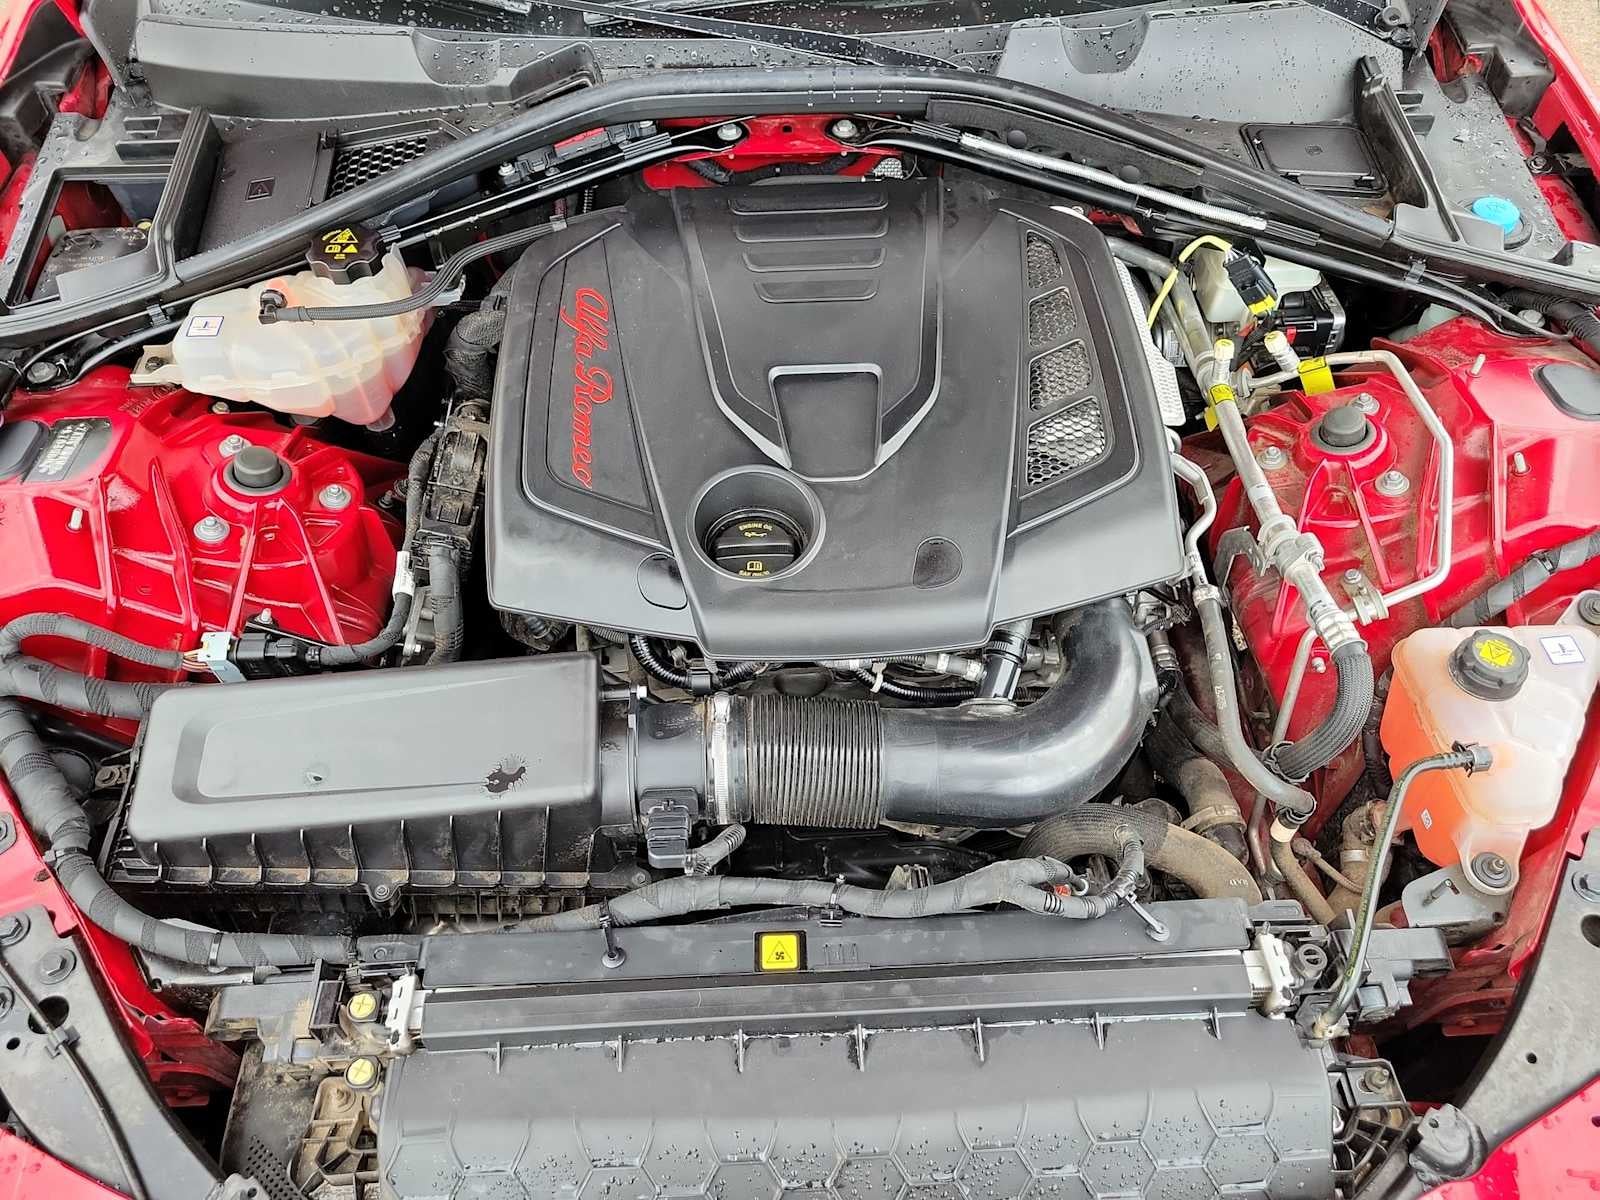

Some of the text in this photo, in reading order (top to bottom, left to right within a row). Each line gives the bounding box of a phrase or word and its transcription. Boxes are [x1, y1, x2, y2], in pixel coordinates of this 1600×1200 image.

[560, 287, 613, 490] Alfa Romeo
[739, 522, 772, 531] ENGINE OIL
